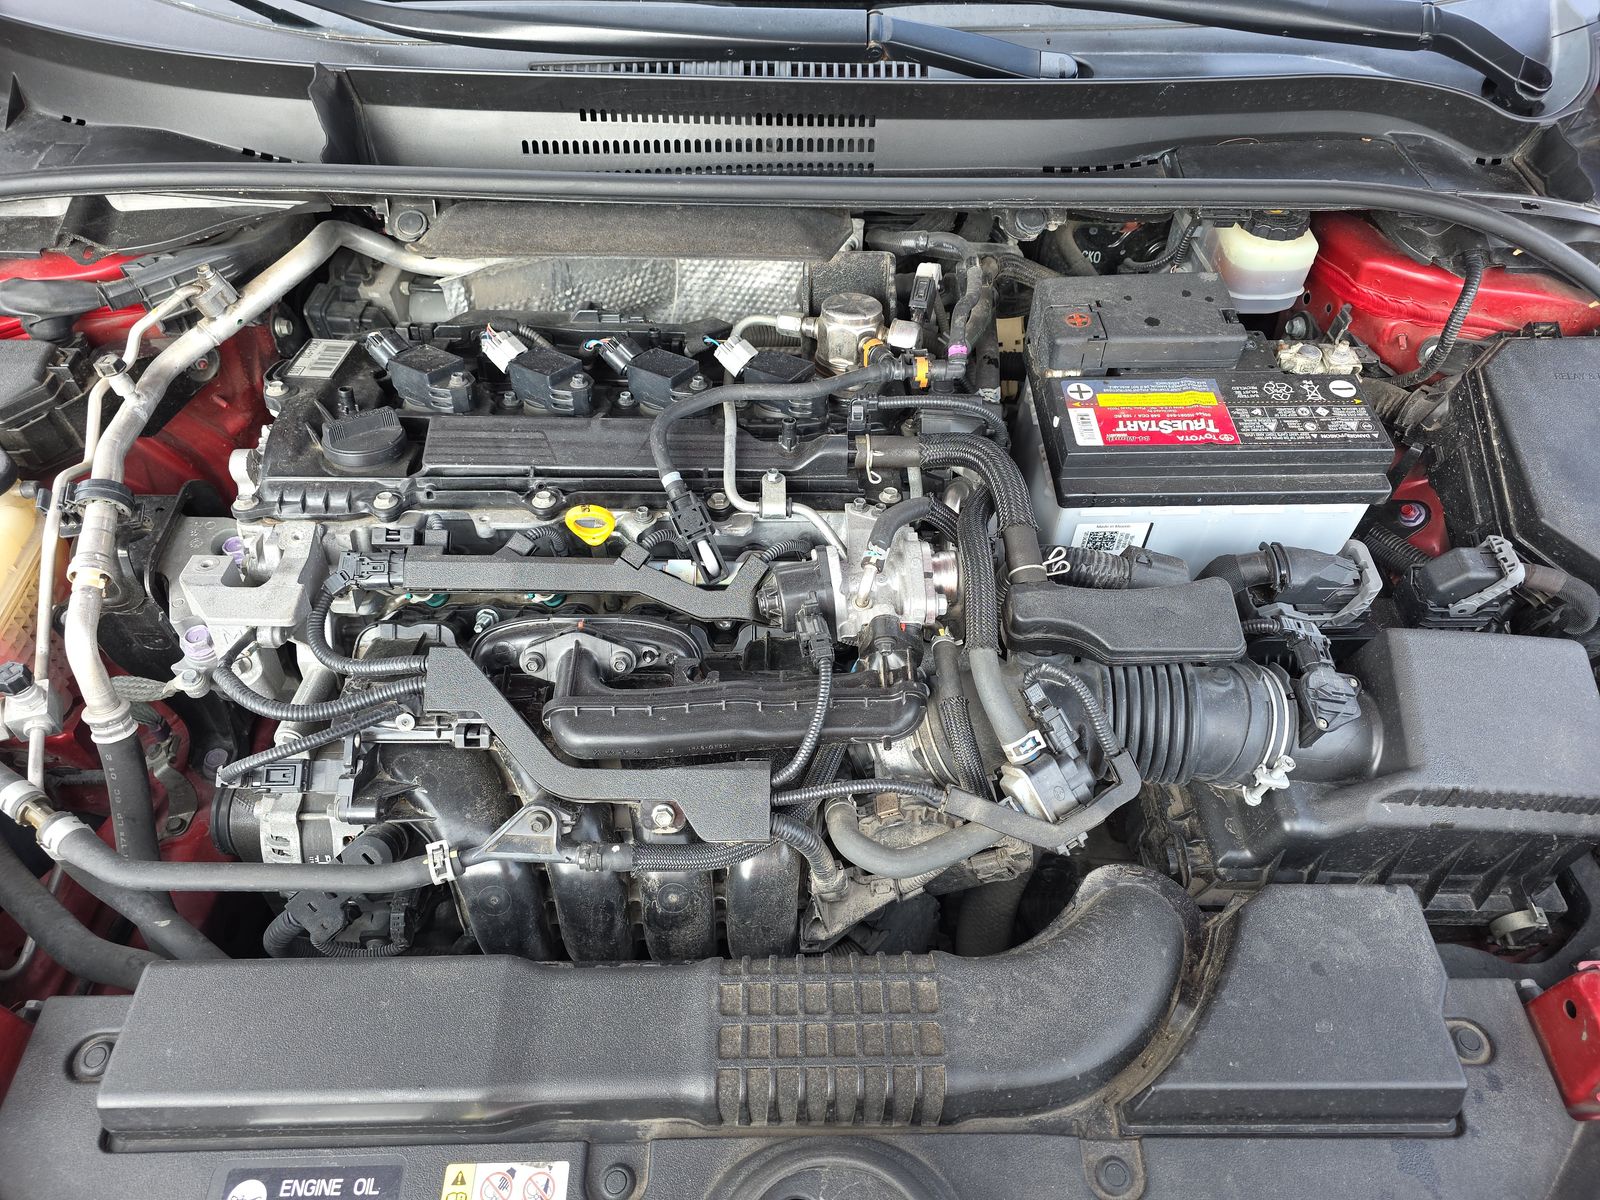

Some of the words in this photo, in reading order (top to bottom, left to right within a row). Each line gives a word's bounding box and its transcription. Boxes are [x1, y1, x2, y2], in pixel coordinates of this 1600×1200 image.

[1176, 433, 1218, 441] TOYOTA
[279, 1178, 344, 1197] ENGINE
[353, 1177, 379, 1196] OIL
